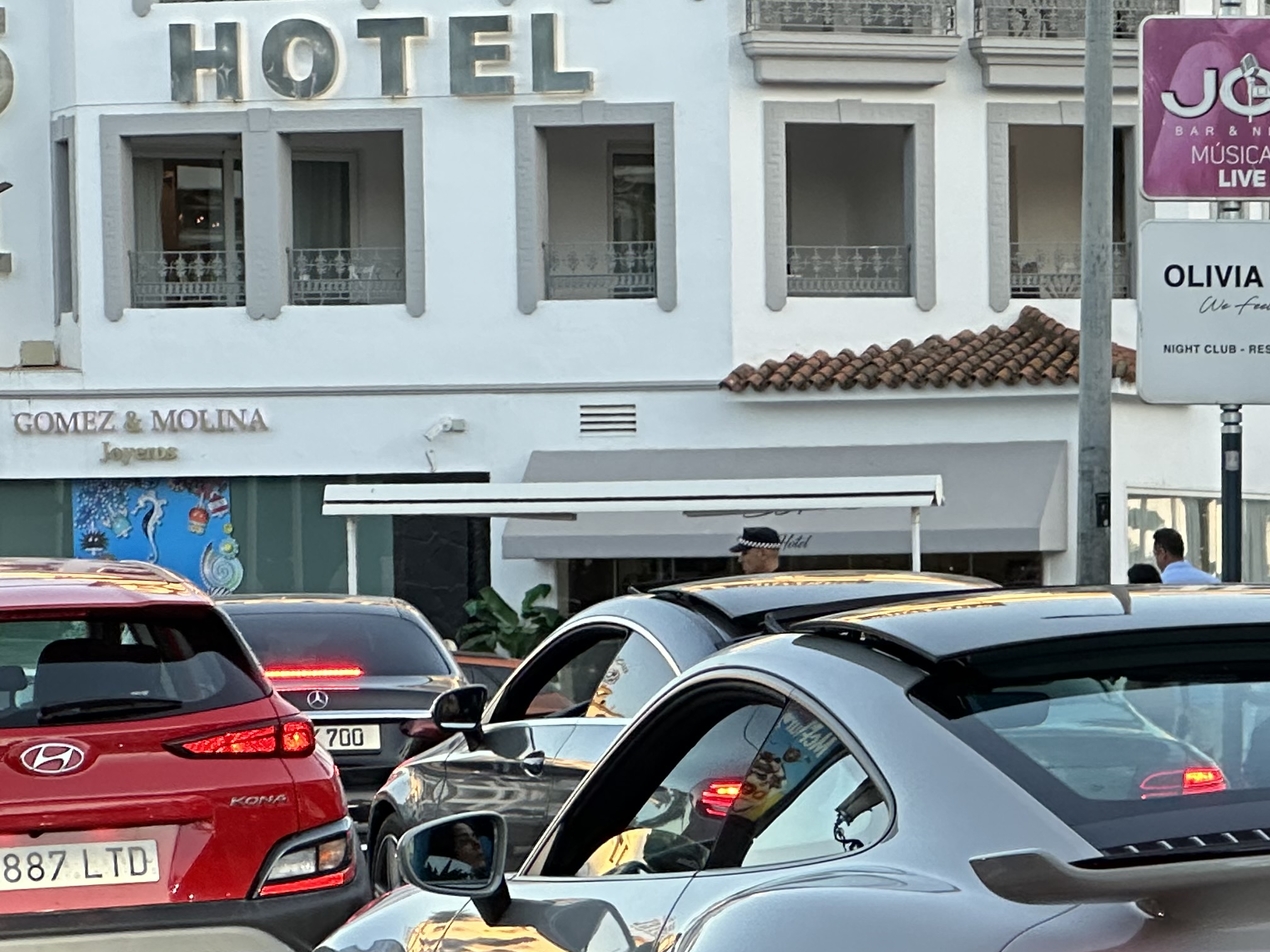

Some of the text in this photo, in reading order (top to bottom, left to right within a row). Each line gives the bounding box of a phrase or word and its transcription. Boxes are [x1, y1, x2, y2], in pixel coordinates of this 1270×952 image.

[168, 13, 594, 102] HOTEL
[1175, 126, 1215, 137] BAR
[1229, 126, 1238, 137] &
[1218, 169, 1266, 188] LIVE
[1164, 264, 1264, 288] OLIVIA
[1199, 295, 1231, 314] We
[1163, 344, 1200, 354] NIGHT
[1204, 344, 1236, 354] CLUB
[14, 408, 269, 435] GOMEZ & MOLINA
[100, 441, 179, 465] Joyeros
[327, 728, 364, 747] 700
[230, 794, 287, 806] KONA
[3, 846, 148, 883] 887 LTD
